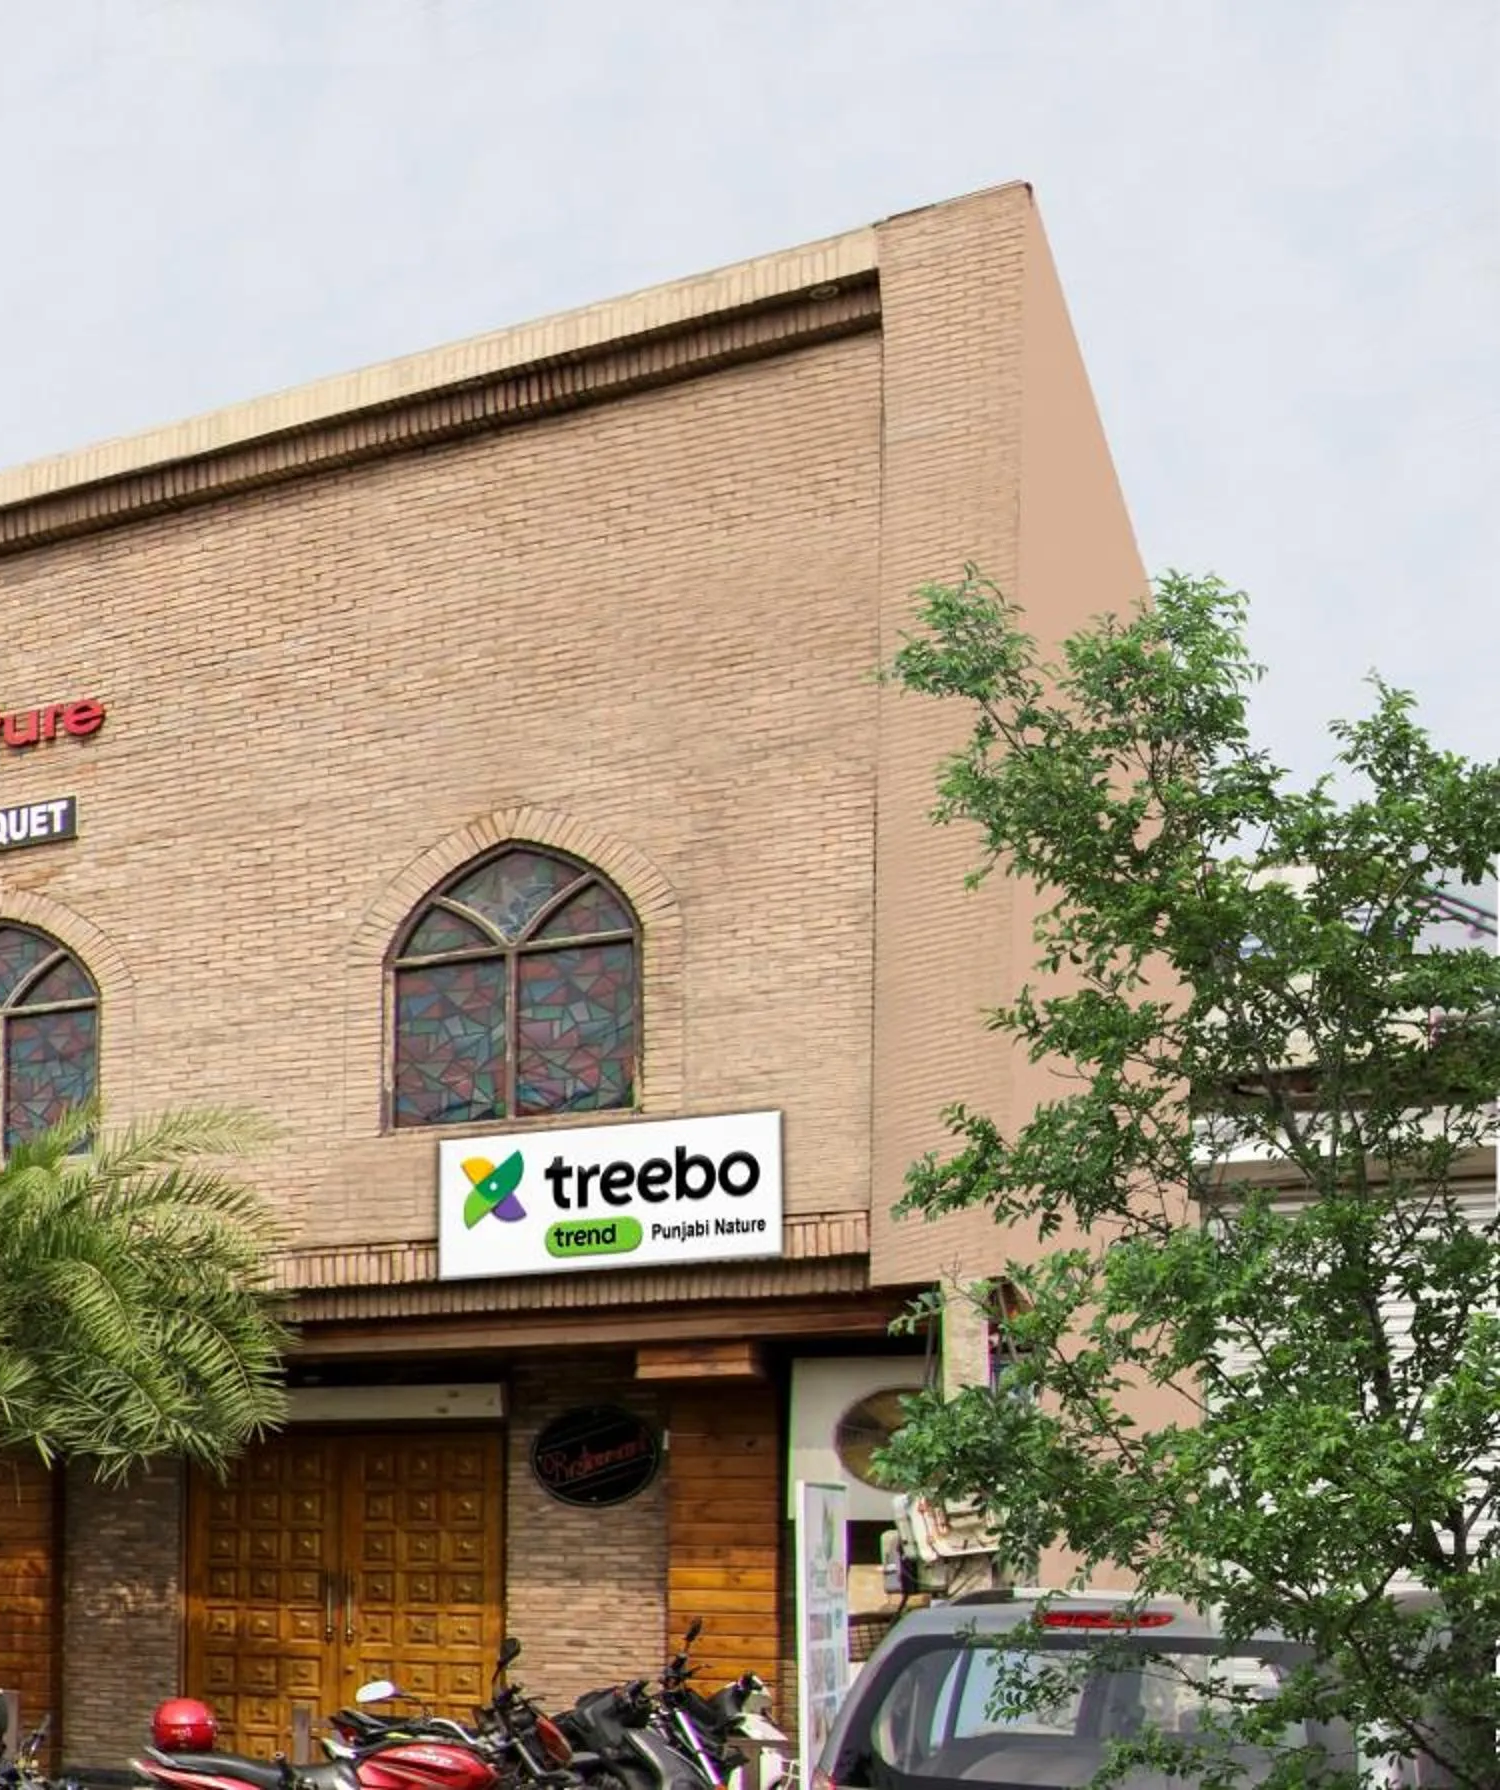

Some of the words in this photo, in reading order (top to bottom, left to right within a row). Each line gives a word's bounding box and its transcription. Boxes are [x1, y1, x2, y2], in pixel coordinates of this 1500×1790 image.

[544, 1145, 761, 1209] treebo
[553, 1223, 618, 1248] trend
[651, 1219, 711, 1243] Punjabi
[713, 1216, 767, 1235] Nature
